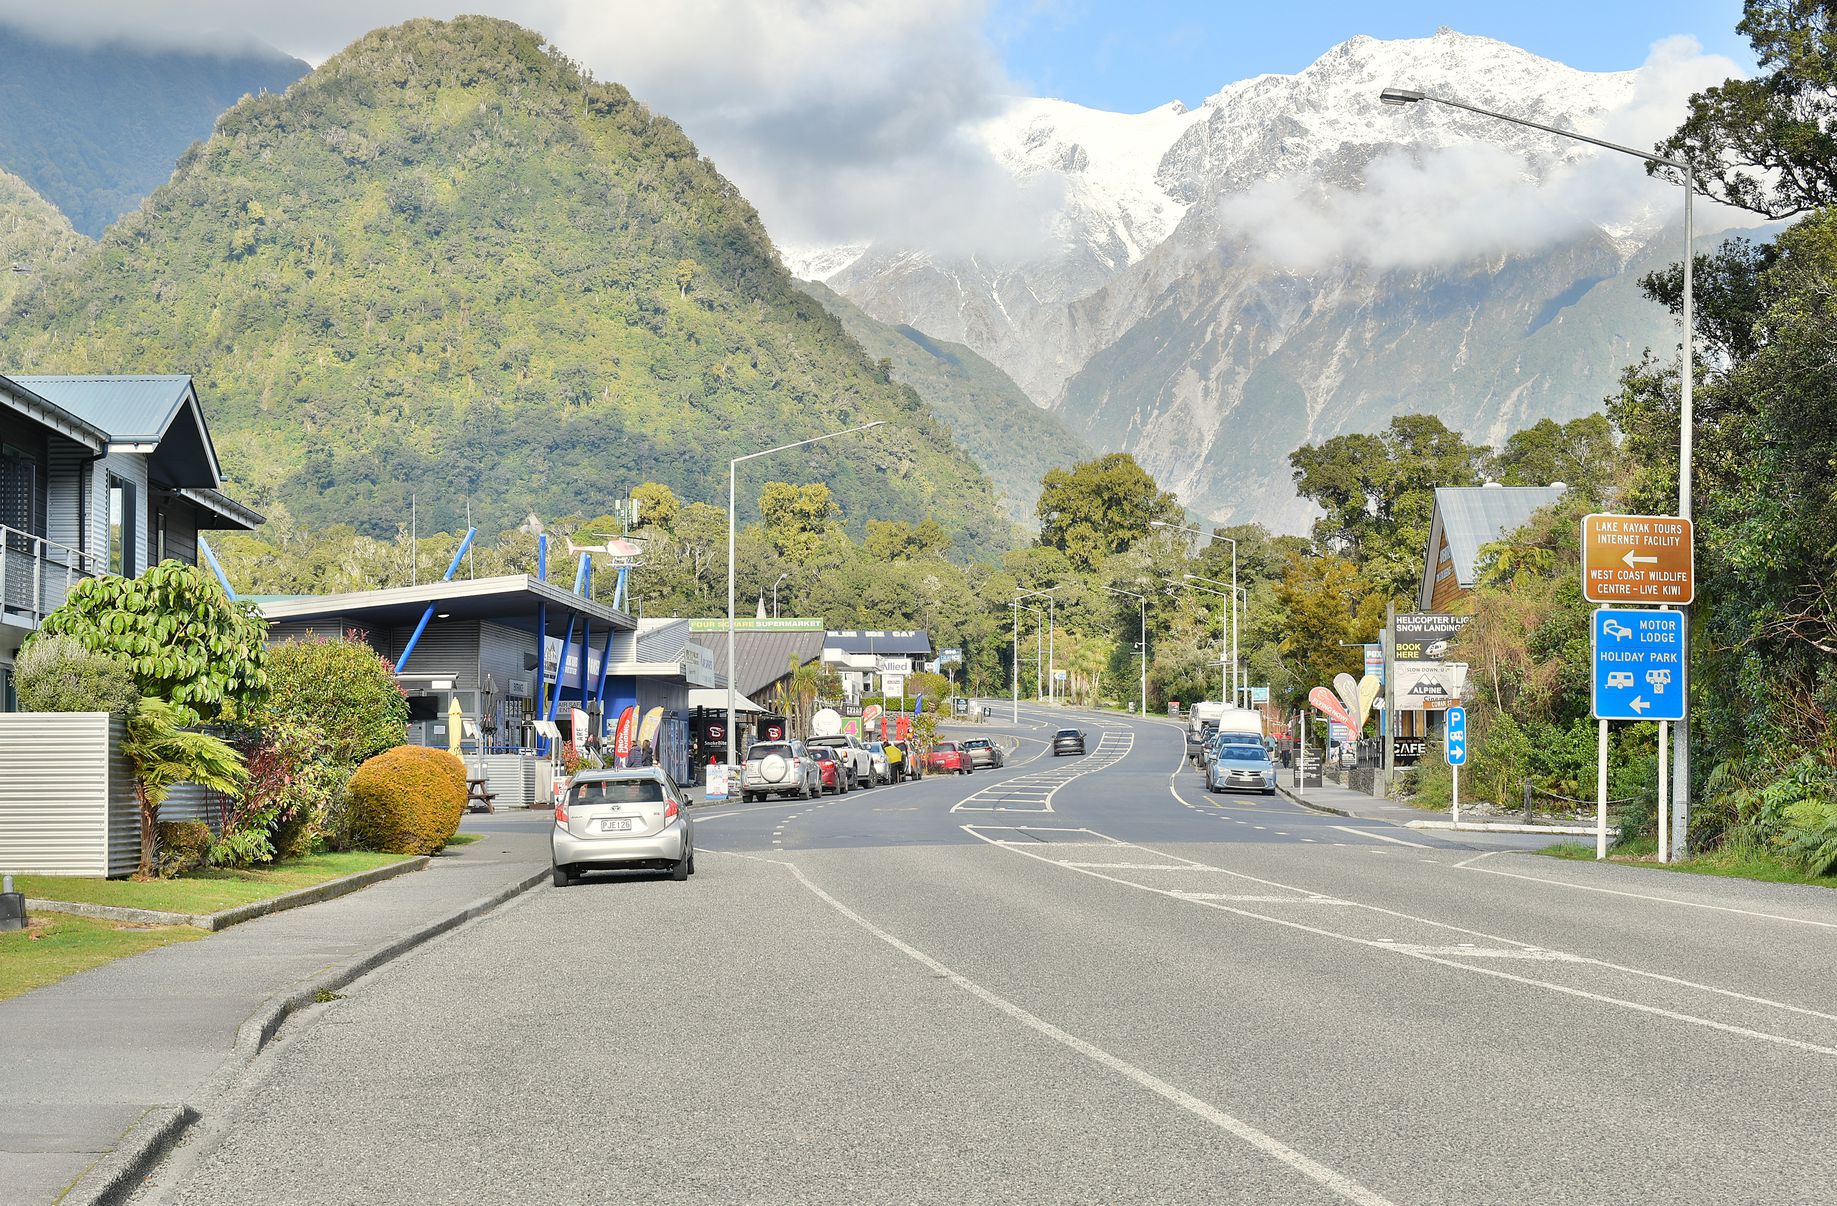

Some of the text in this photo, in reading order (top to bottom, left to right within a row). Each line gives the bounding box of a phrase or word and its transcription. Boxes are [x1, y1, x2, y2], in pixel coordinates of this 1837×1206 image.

[1596, 522, 1682, 534] LAKE KAYAK TOURS
[1598, 535, 1680, 546] INTERNET FACILITY
[1590, 570, 1688, 582] WEST COAST WILDLIFE
[1598, 584, 1630, 594] CENTRE
[1640, 584, 1658, 595] LIVE
[1662, 585, 1681, 596] KIWI
[1640, 620, 1676, 630] MOTOR
[1640, 632, 1676, 642] LODGE
[1600, 652, 1678, 663] HOLIDAY PARK
[1312, 698, 1332, 712] FLYING
[1452, 712, 1461, 726] P
[1394, 743, 1426, 754] CAFE
[602, 820, 630, 829] PJE126
